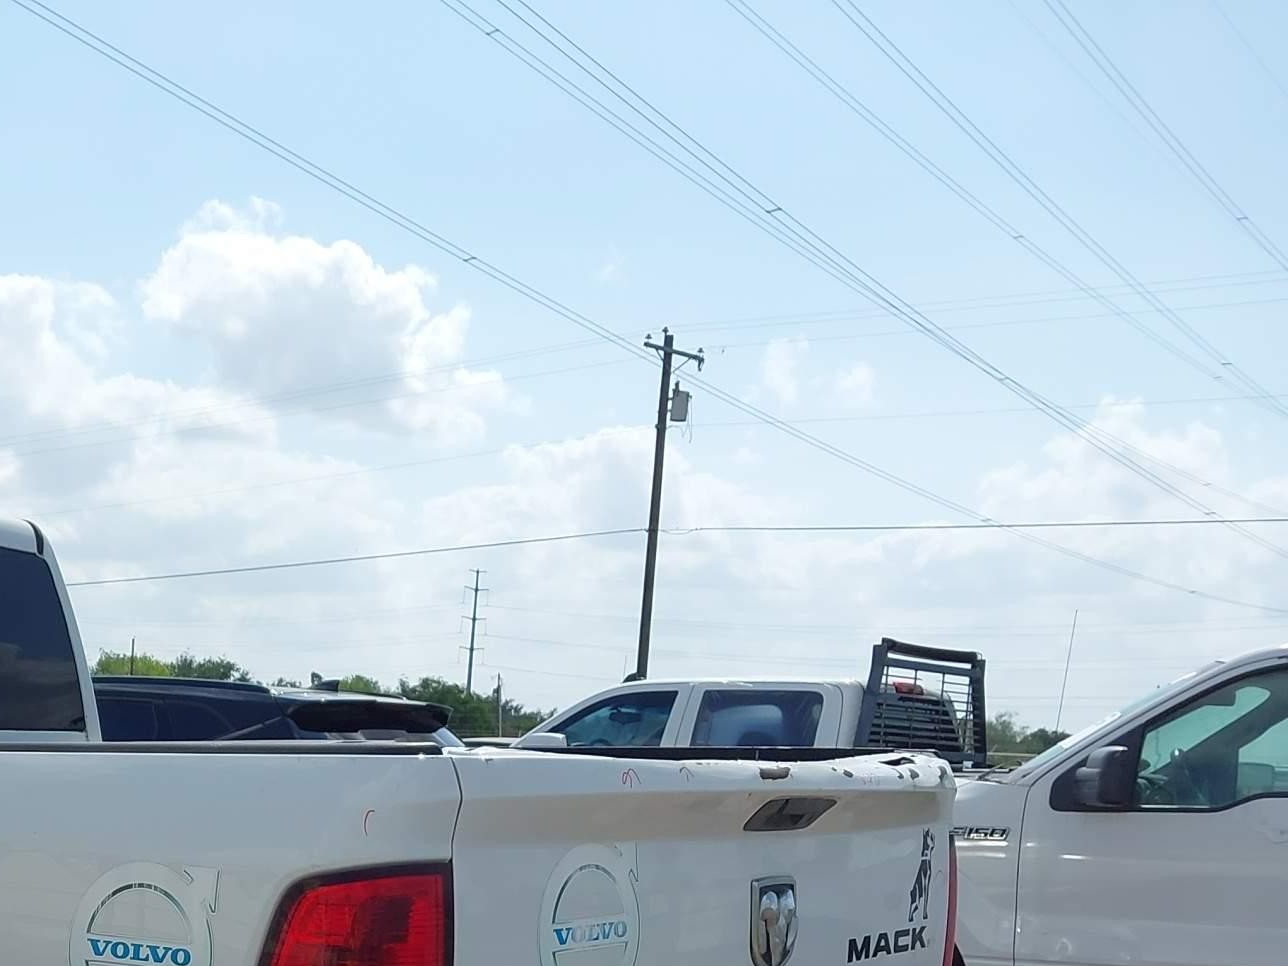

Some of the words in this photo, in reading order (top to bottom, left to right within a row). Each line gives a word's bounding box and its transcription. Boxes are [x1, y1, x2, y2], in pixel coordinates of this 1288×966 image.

[553, 921, 628, 946] VOLVO
[846, 926, 927, 963] MACK
[87, 938, 191, 966] VOLVO
